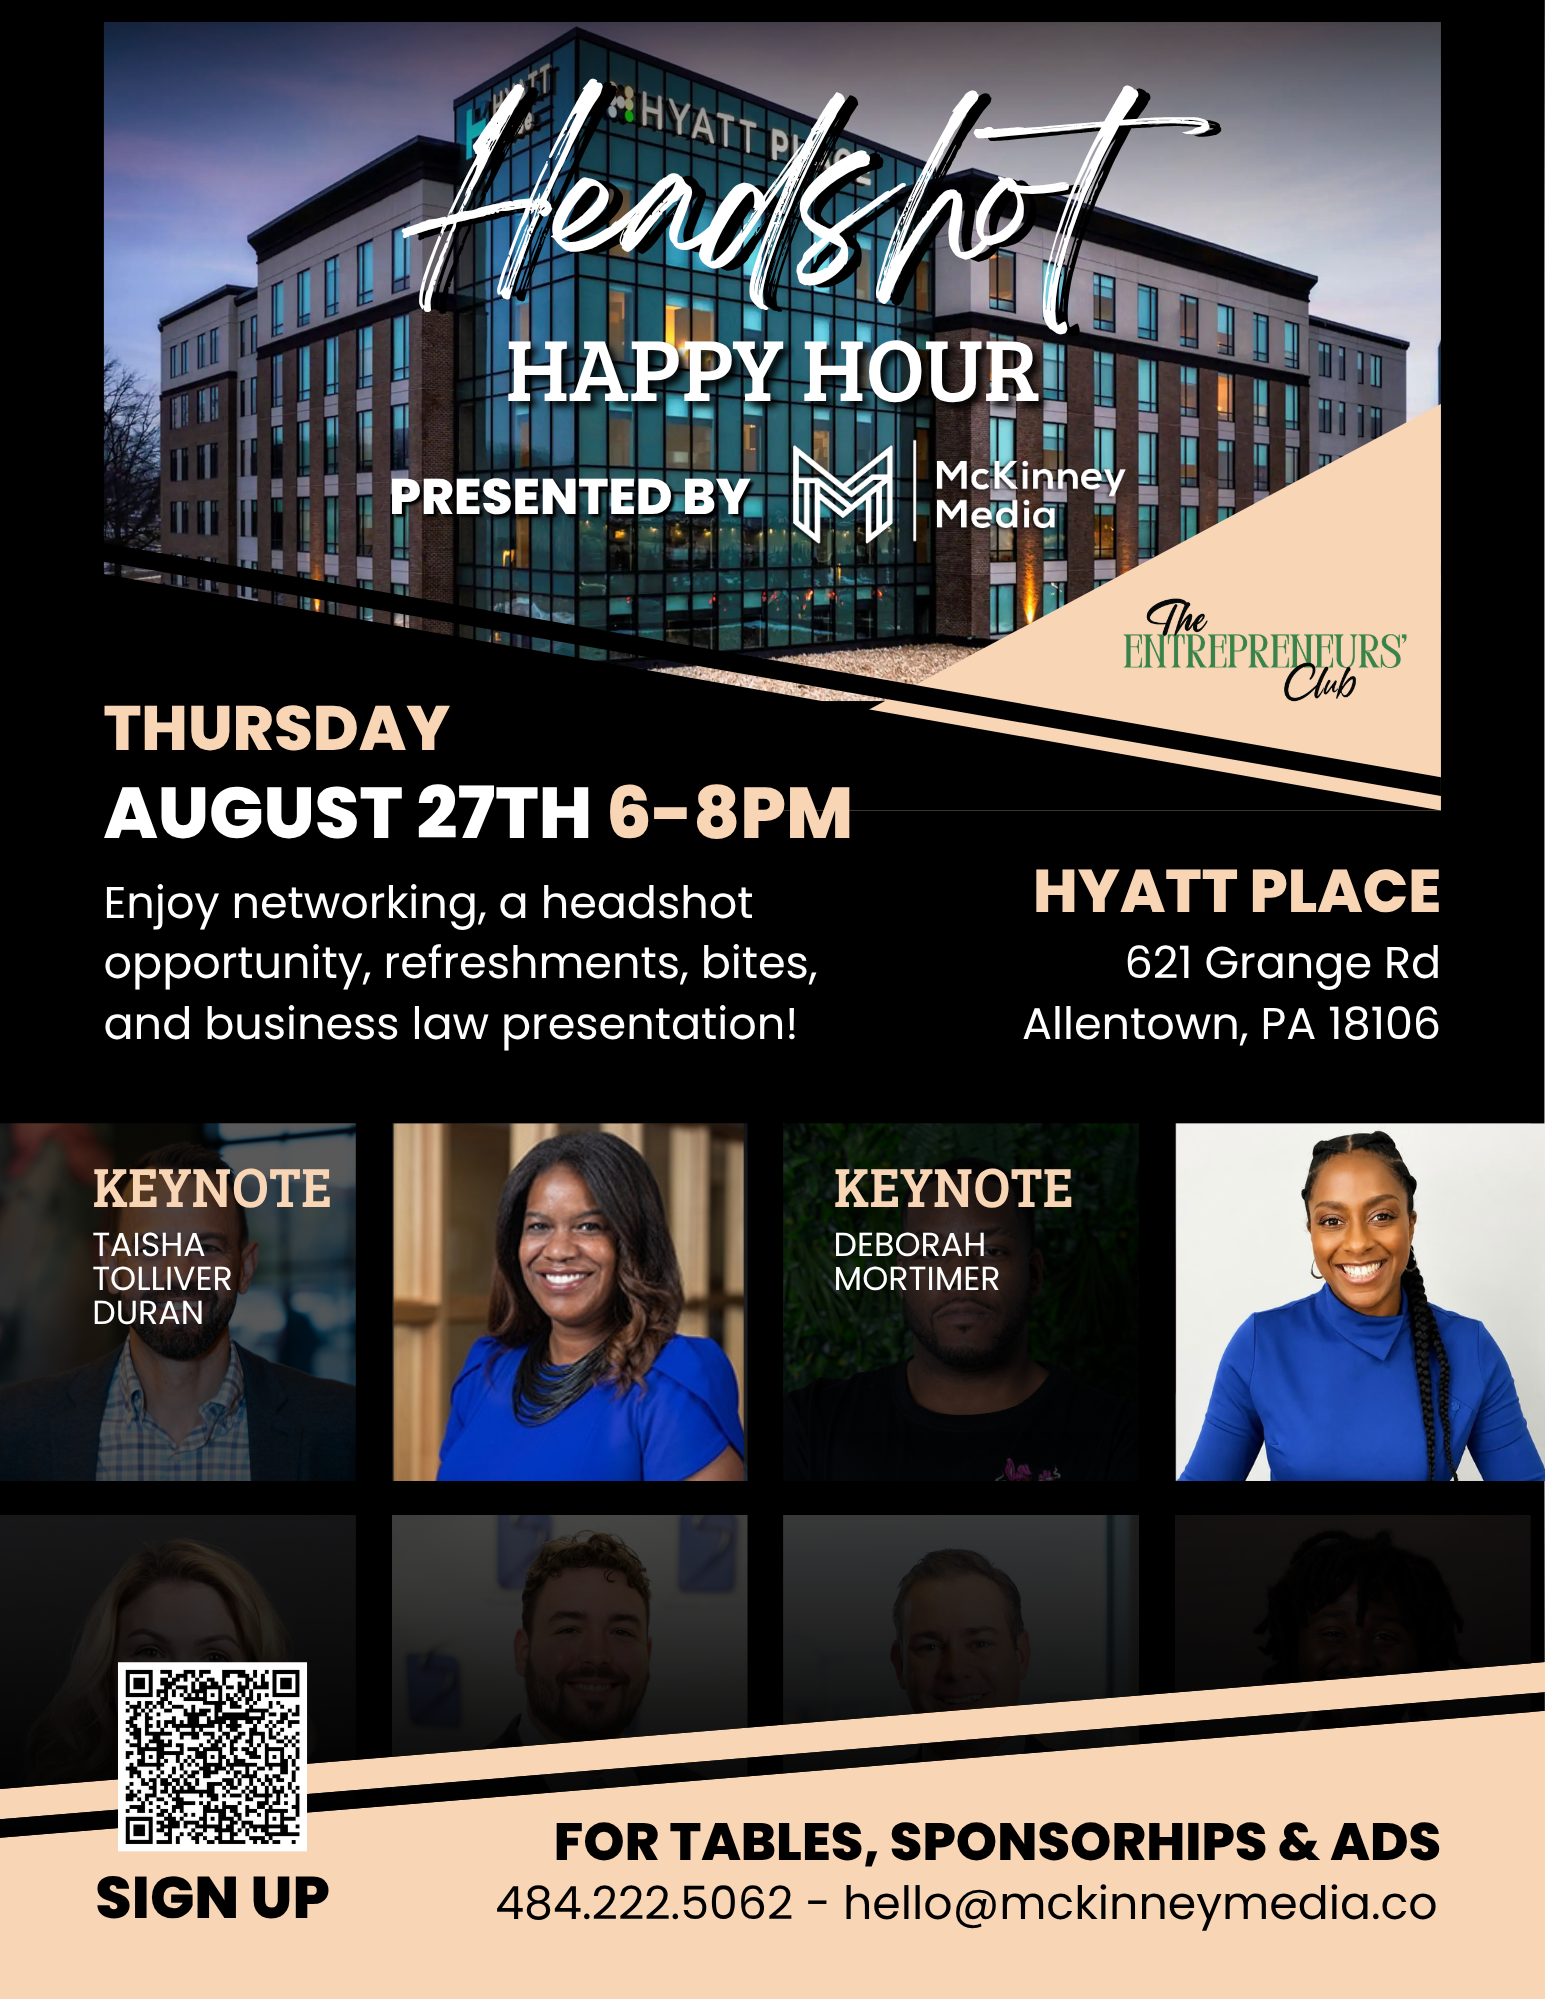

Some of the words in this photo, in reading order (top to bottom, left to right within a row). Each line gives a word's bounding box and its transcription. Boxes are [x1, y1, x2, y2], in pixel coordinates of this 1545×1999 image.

[641, 91, 757, 154] HYATT
[402, 79, 1211, 334] Headshot
[508, 341, 784, 402] HAPPY
[804, 340, 1039, 403] HOUR
[391, 478, 672, 515] PRESENTED
[684, 478, 751, 515] BY
[936, 460, 1126, 497] McKinney
[936, 499, 1055, 529] Media
[1146, 598, 1208, 637] The
[1283, 662, 1357, 702] Club
[104, 704, 451, 751] THURSDAY
[103, 786, 403, 839] AUGUST
[418, 784, 589, 839] 27TH
[106, 884, 220, 931] Enjoy
[234, 884, 486, 931] networking,
[499, 892, 526, 919] a
[543, 884, 753, 920] headshot
[1035, 869, 1238, 913] HYATT
[1252, 868, 1440, 913] PLACE
[104, 943, 371, 991] opportunity,
[386, 943, 688, 986] refreshments,
[703, 943, 817, 986] bites,
[1127, 944, 1189, 979] 621
[1205, 946, 1371, 991] Grange
[1386, 944, 1439, 979] Rd
[104, 1005, 190, 1041] and
[207, 1005, 398, 1041] business
[414, 1005, 489, 1040] law
[503, 1005, 796, 1052] presentation!
[1023, 1005, 1248, 1047] Allentown,
[1263, 1007, 1316, 1040] PA
[1329, 1005, 1439, 1041] 18106
[93, 1168, 331, 1209] KEYNOTE
[834, 1168, 1072, 1209] KEYNOTE
[92, 1231, 206, 1257] TAISHA
[835, 1231, 985, 1257] DEBORAH
[92, 1265, 232, 1291] TOLLIVER
[835, 1265, 999, 1291] MORTIMER
[94, 1300, 203, 1325] DURAN
[556, 1821, 659, 1861] FOR
[669, 1821, 878, 1867] TABLES,
[891, 1821, 1266, 1861] SPONSORHIPS
[1279, 1821, 1321, 1861] &
[1330, 1821, 1440, 1861] ADS
[97, 1875, 237, 1919] SIGN
[253, 1876, 329, 1919] UP
[496, 1884, 792, 1921] 484.222.5062
[846, 1883, 1437, 1932] hello@mckinneymedia.co
